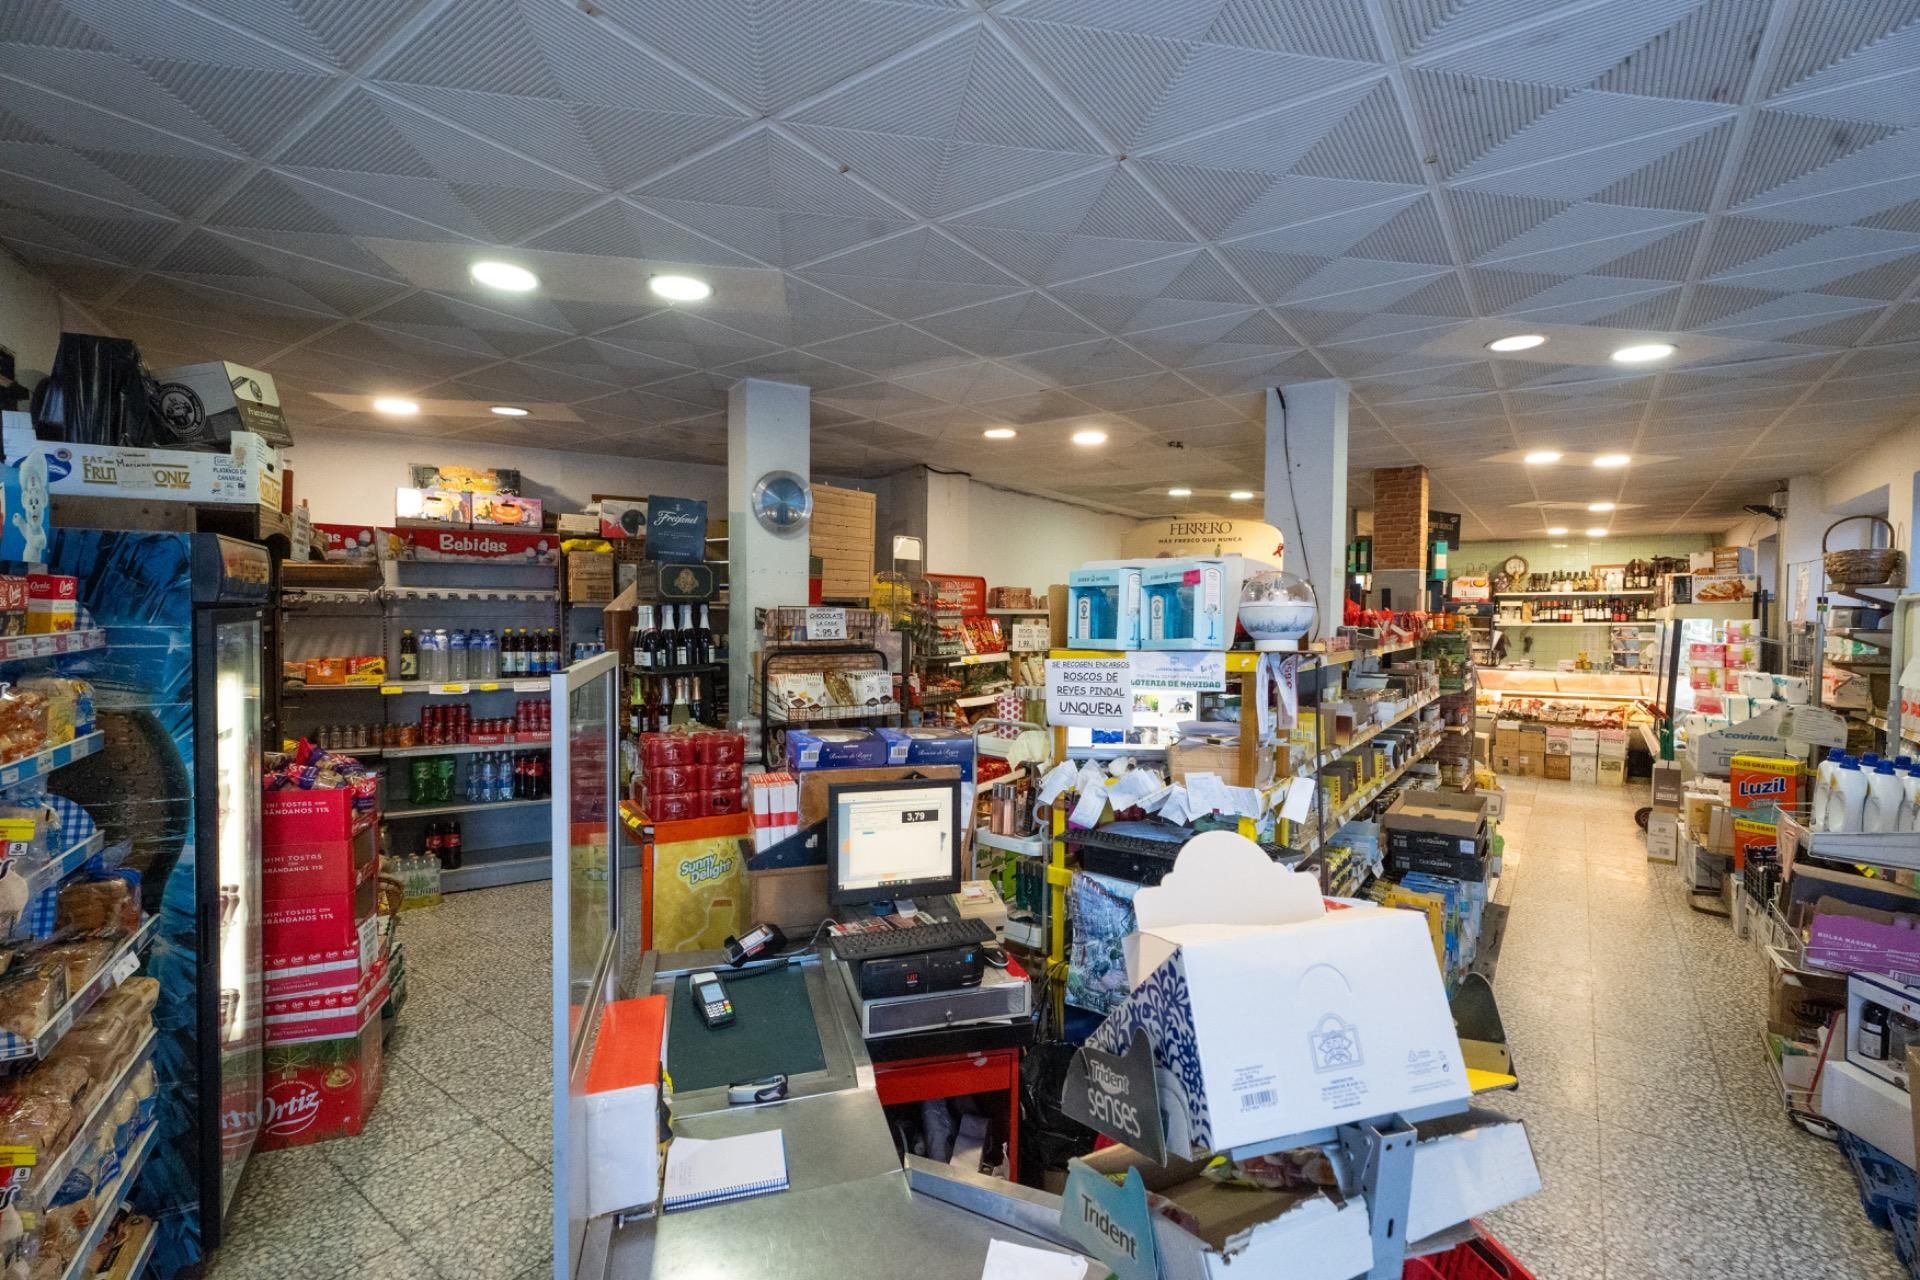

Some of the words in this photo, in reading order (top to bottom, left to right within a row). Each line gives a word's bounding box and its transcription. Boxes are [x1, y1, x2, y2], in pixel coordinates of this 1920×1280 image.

[1170, 521, 1232, 535] FERRERO
[439, 534, 507, 552] Bebidas
[1063, 672, 1102, 681] ROSCOS
[1106, 672, 1118, 681] DE
[1131, 679, 1166, 687] LOTERIA
[1057, 686, 1087, 695] REYES
[1089, 686, 1125, 697] PINDAL
[1059, 701, 1123, 715] UNQUERA
[1739, 777, 1786, 796] Luzil
[907, 812, 925, 822] 3,79
[1757, 825, 1776, 833] GRATI
[680, 853, 718, 876] Sunny
[690, 858, 732, 885] Delight
[286, 908, 317, 916] TOSTAS
[1090, 1060, 1130, 1095] Trident
[1087, 1087, 1141, 1139] senses
[1081, 1194, 1137, 1261] Trident
